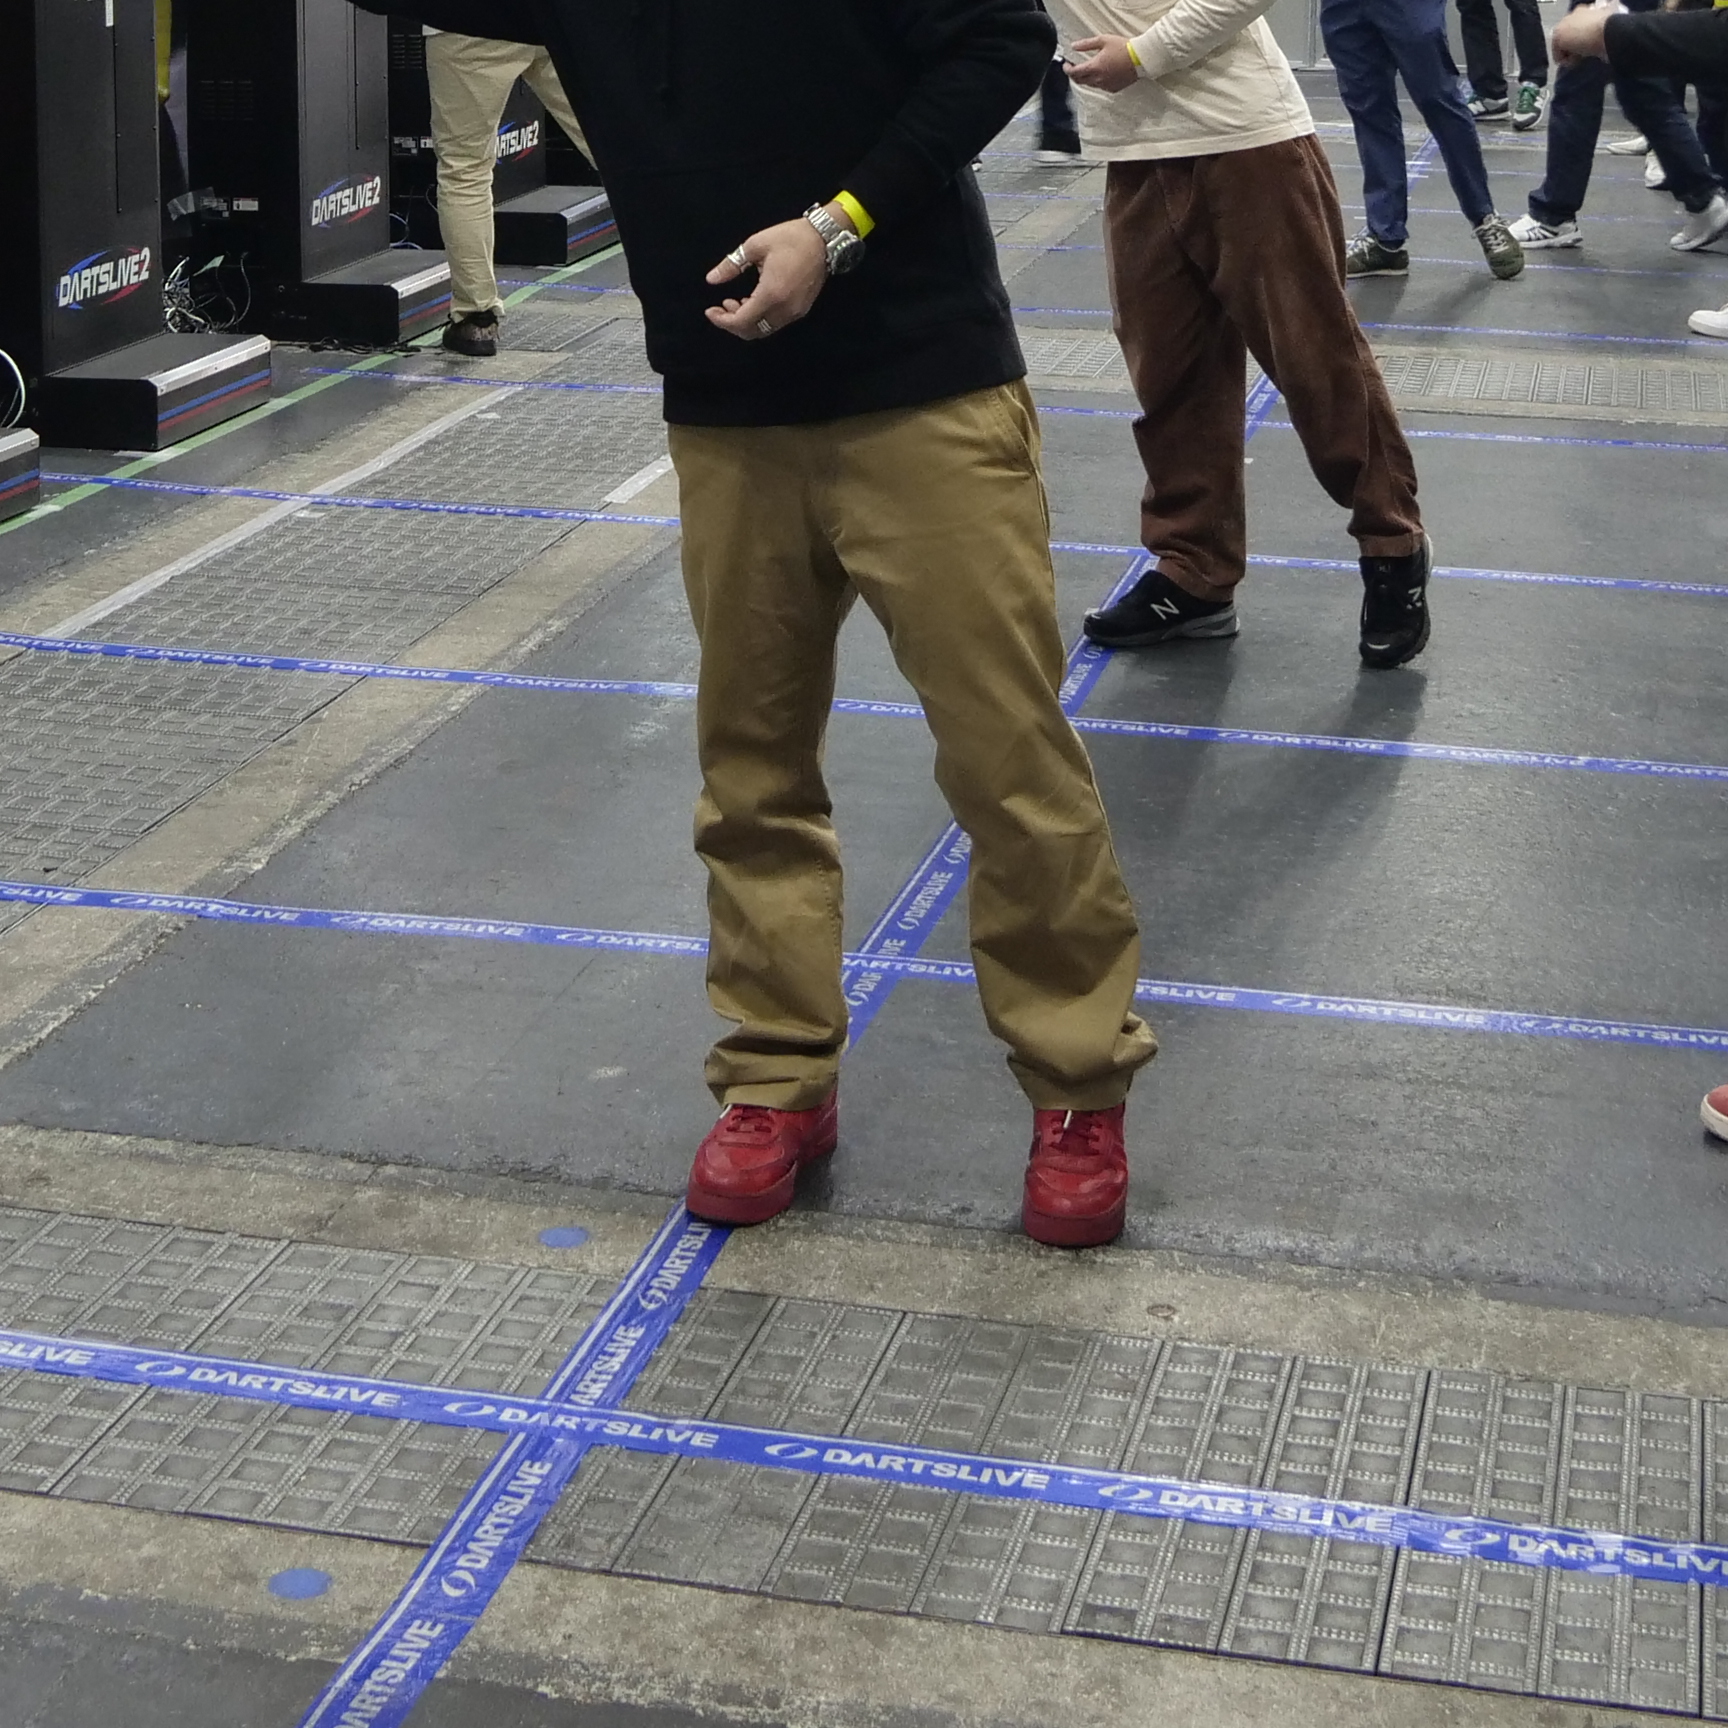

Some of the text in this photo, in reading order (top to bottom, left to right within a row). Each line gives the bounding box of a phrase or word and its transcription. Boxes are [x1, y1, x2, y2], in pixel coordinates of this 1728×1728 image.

[497, 120, 539, 159] ARTSLIVE2
[311, 175, 382, 227] DARTSLIVE2
[57, 246, 151, 308] DARTSLIVE2
[1149, 598, 1180, 621] N
[326, 660, 451, 681] DARTSLIVE
[501, 674, 630, 692] DARTSLIVE
[1249, 733, 1386, 752] DARTSLIVE
[143, 896, 303, 923] DARTSLIVE
[364, 915, 526, 939] DARTSLIVE
[595, 933, 710, 954] DARTSL
[1137, 982, 1237, 1004] TSLIVE
[650, 1222, 713, 1290] DARTSLI
[571, 1323, 645, 1405] ARTSLIVE
[188, 1366, 404, 1409] DARTSLIVE
[498, 1406, 721, 1450] DARTSLIVE
[821, 1447, 1053, 1491] DARTSLIVE
[1158, 1487, 1396, 1534] DARTSLIVE
[461, 1458, 554, 1573] DARTSLIVE
[334, 1619, 446, 1728] ARTSLIVE
